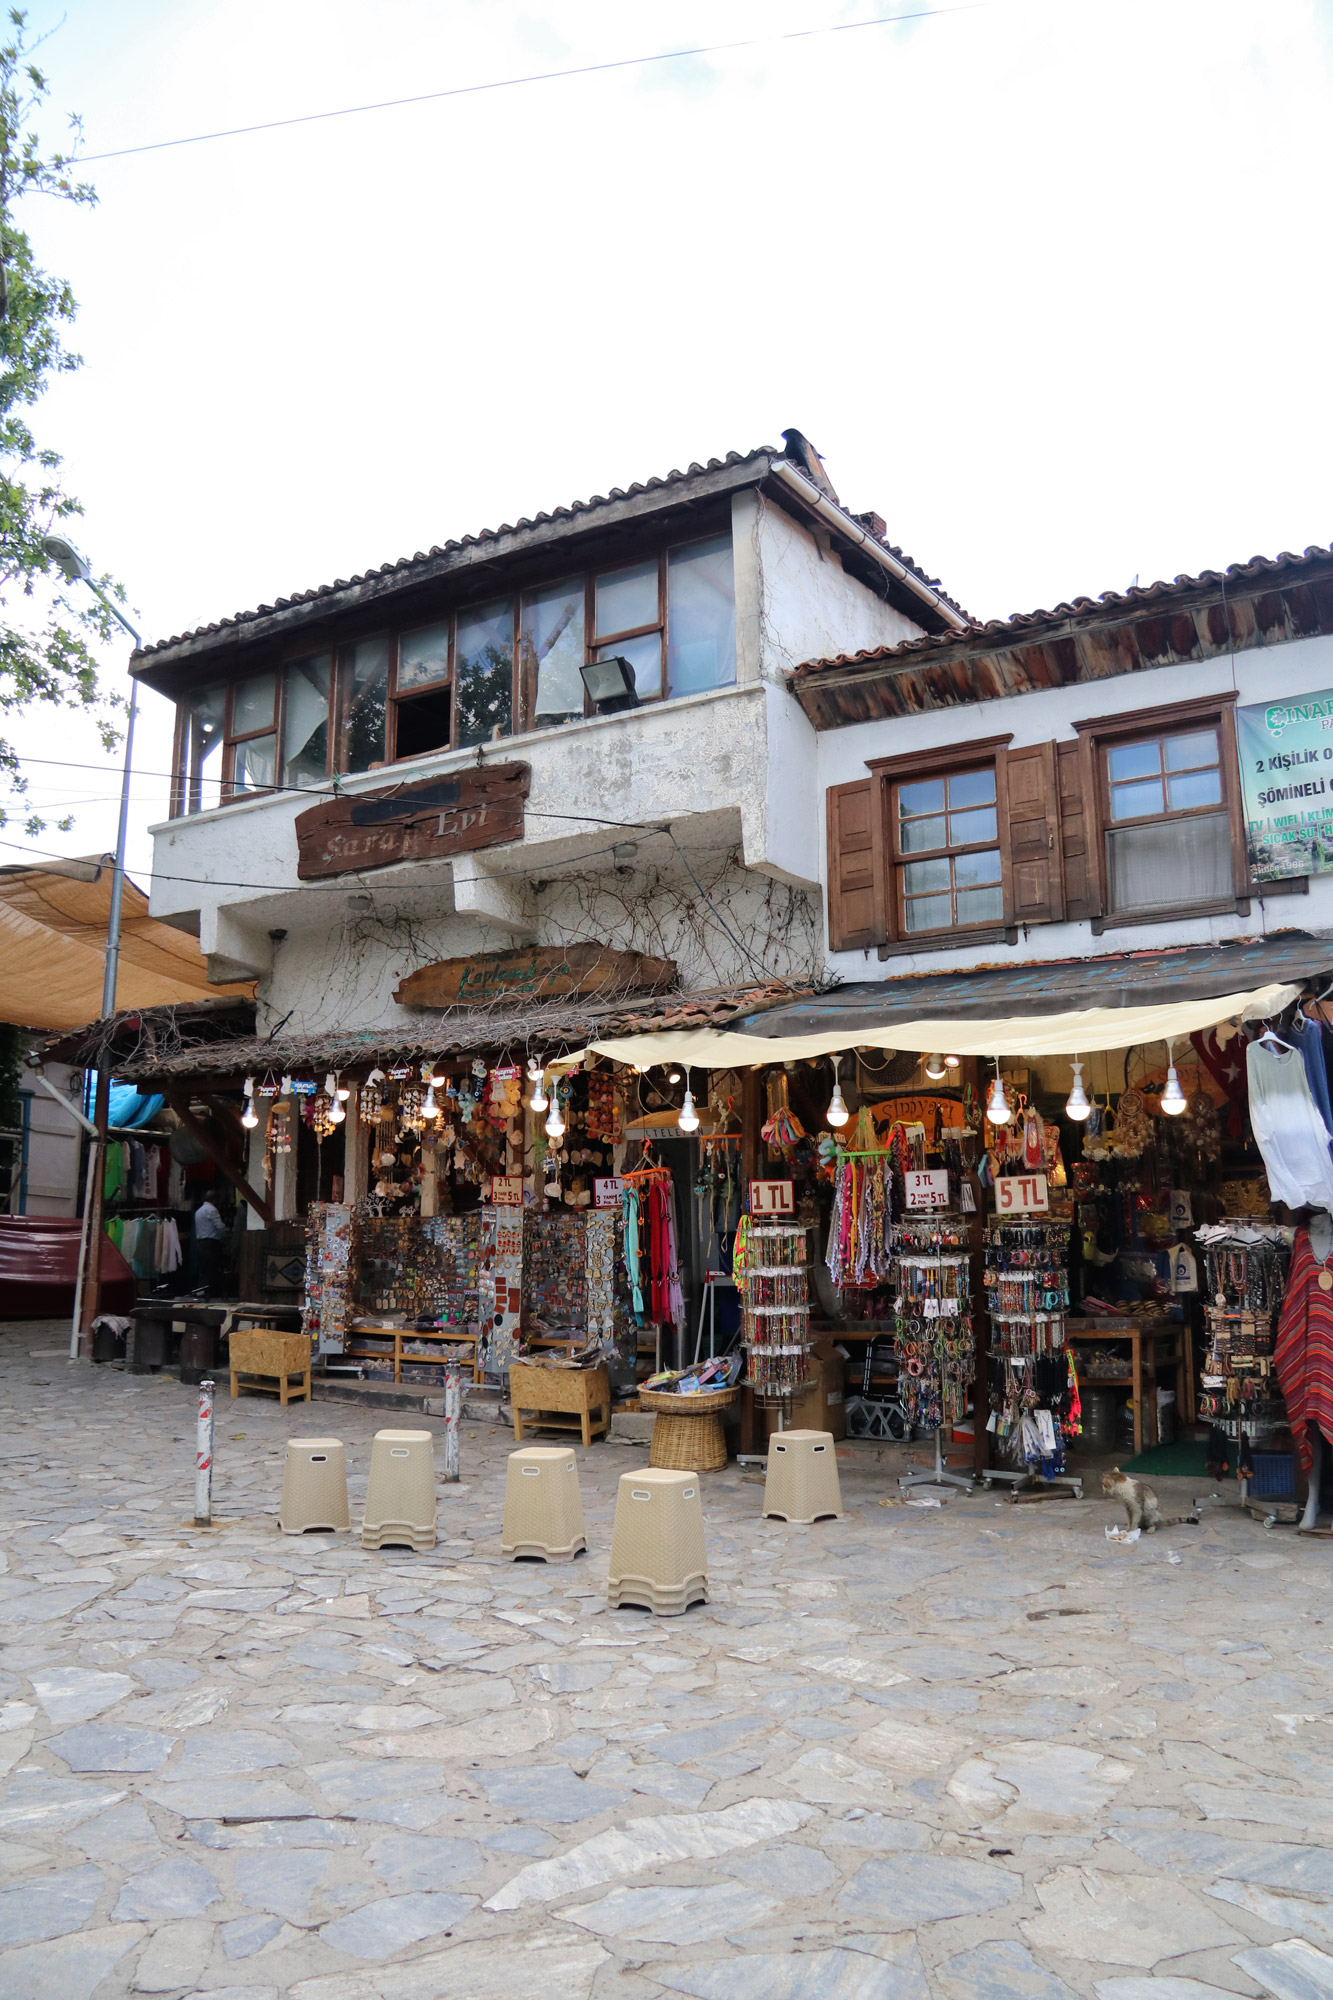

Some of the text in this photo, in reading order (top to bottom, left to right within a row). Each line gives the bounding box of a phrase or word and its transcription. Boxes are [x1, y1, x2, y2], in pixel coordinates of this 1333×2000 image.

[1256, 760, 1264, 773] 2
[1268, 748, 1319, 771] KİŞİLİK
[1257, 777, 1325, 808] ŞÖMİNELİ
[434, 803, 490, 837] Evi
[1249, 820, 1263, 833] TV
[1273, 814, 1297, 828] WIFI
[1262, 830, 1297, 845] SICAK
[1299, 827, 1314, 840] SU
[498, 1177, 512, 1187] 2 TL
[603, 1180, 618, 1190] 4 TL
[915, 1174, 933, 1187] 3 TL
[494, 1191, 498, 1201] 3
[508, 1191, 512, 1201] 5
[513, 1193, 519, 1201] TL
[596, 1195, 601, 1205] 3
[753, 1184, 789, 1209] 1 TL
[910, 1192, 916, 1205] 2
[930, 1191, 936, 1204] 5
[937, 1193, 946, 1203] TL
[1000, 1178, 1044, 1208] 5 TL
